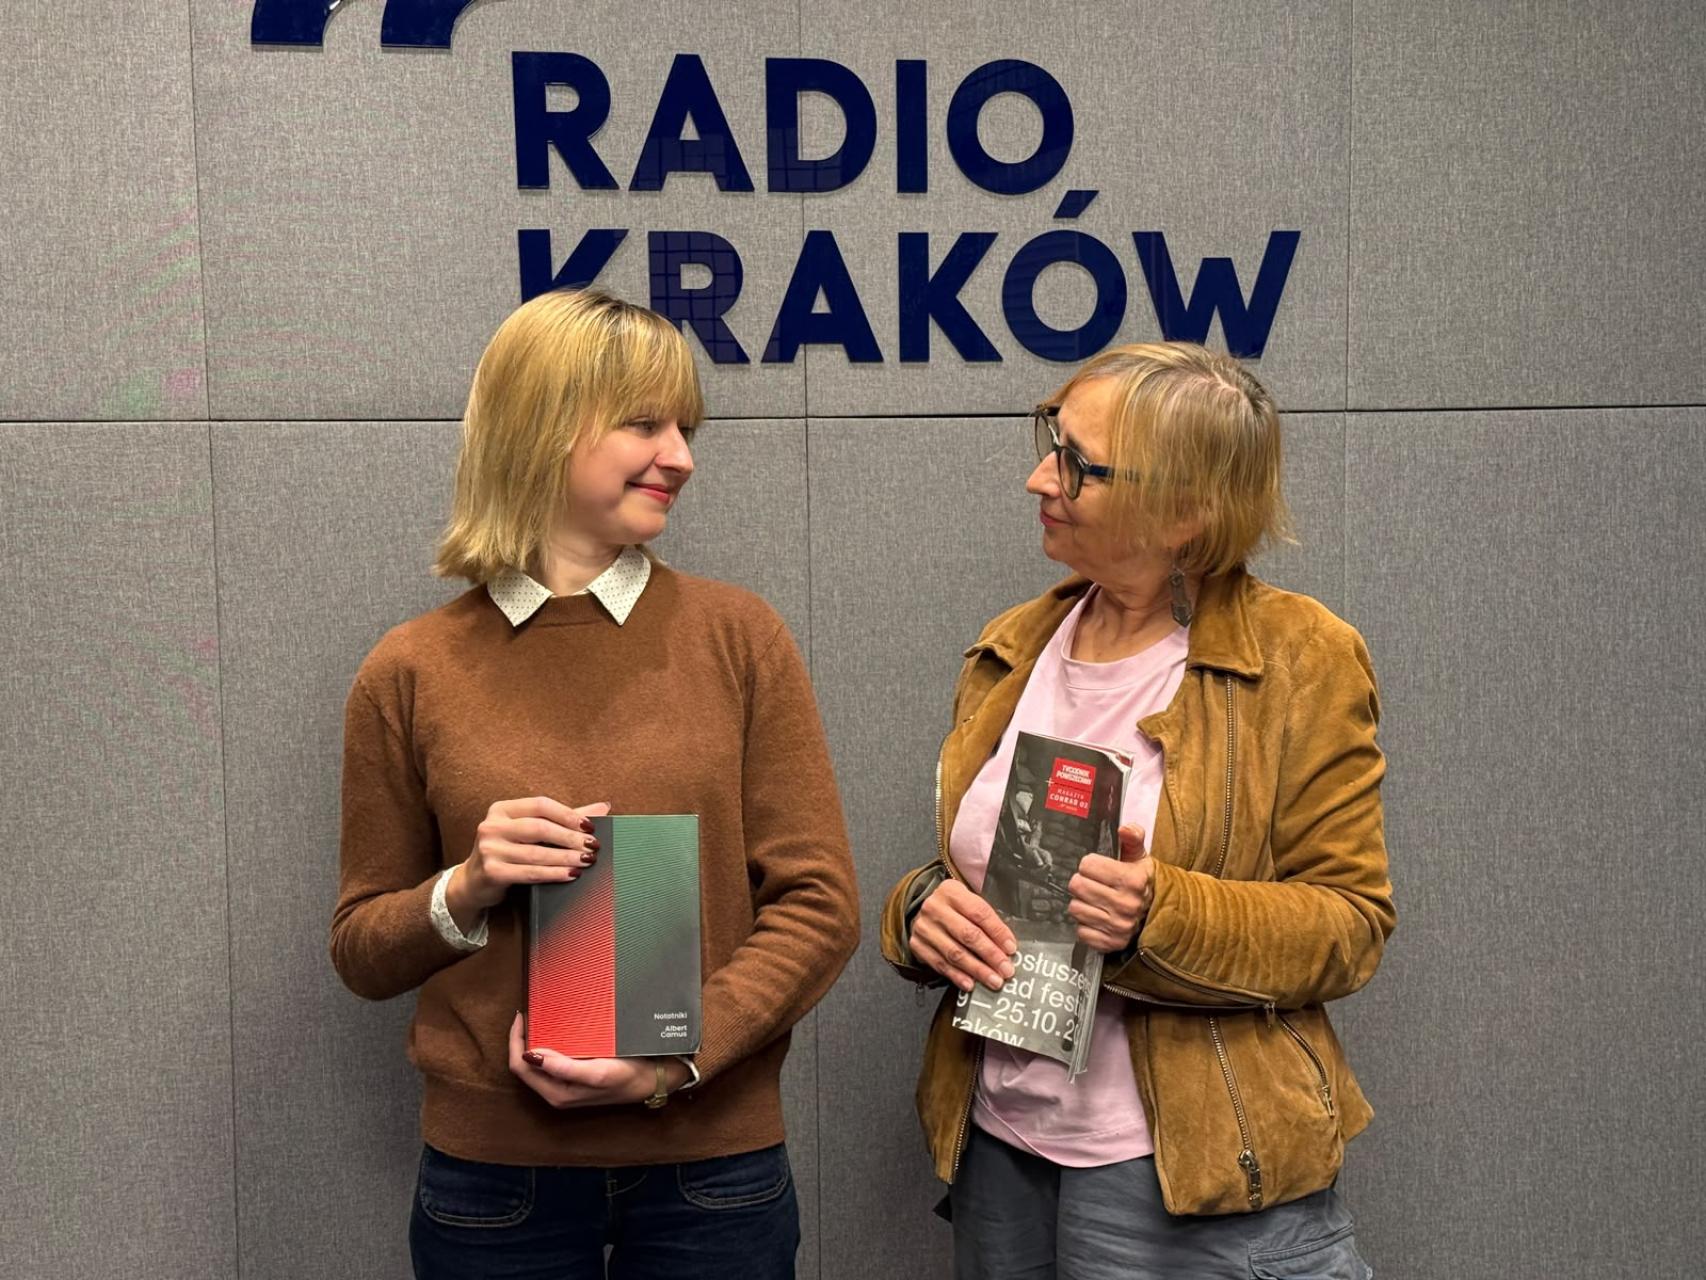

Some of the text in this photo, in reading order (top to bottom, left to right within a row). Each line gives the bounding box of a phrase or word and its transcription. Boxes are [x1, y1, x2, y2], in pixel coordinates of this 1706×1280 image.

[512, 51, 1075, 195] RADIO
[518, 190, 1302, 365] KRAKÓW
[654, 1012, 687, 1020] Notatniki
